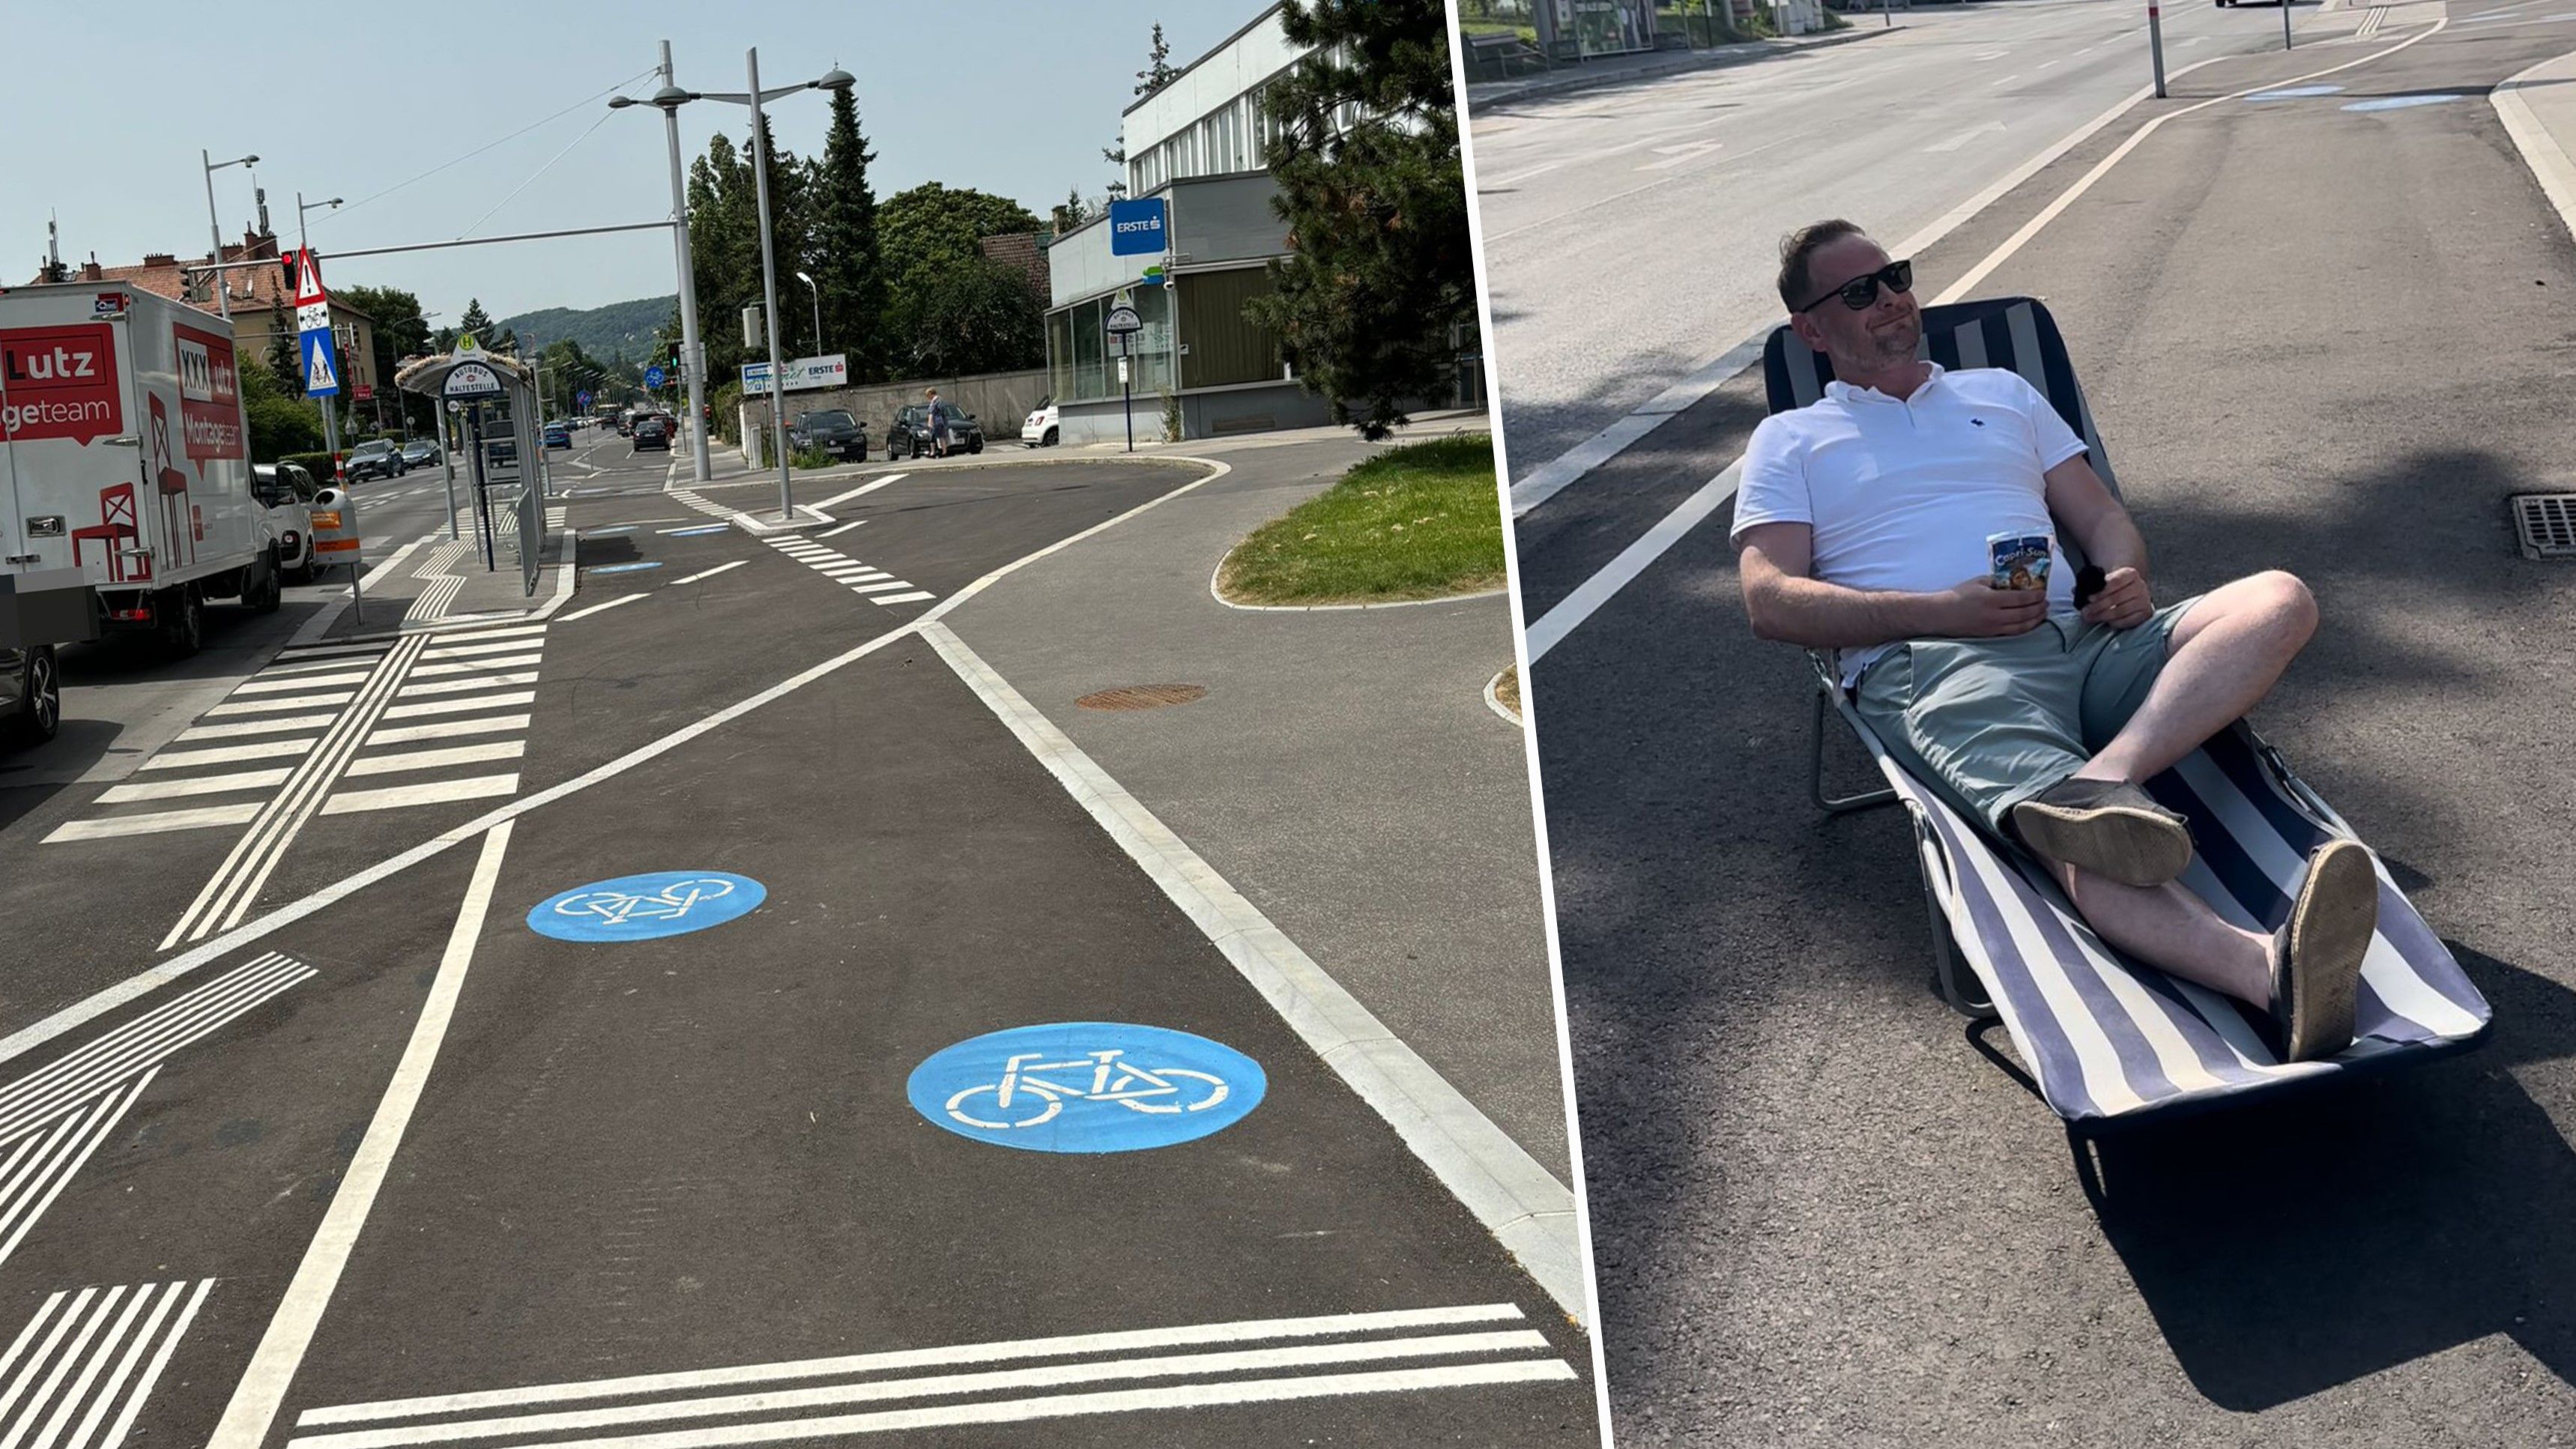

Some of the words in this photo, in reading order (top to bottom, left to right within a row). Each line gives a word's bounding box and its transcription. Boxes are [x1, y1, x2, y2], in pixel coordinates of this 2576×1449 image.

[1117, 220, 1149, 233] ERSTE
[454, 366, 489, 378] AUTOBUS
[808, 364, 834, 375] ERSTE
[450, 382, 495, 392] HALTESTELLE
[0, 399, 110, 432] geteam
[1995, 547, 2047, 566] Capri-Sun
